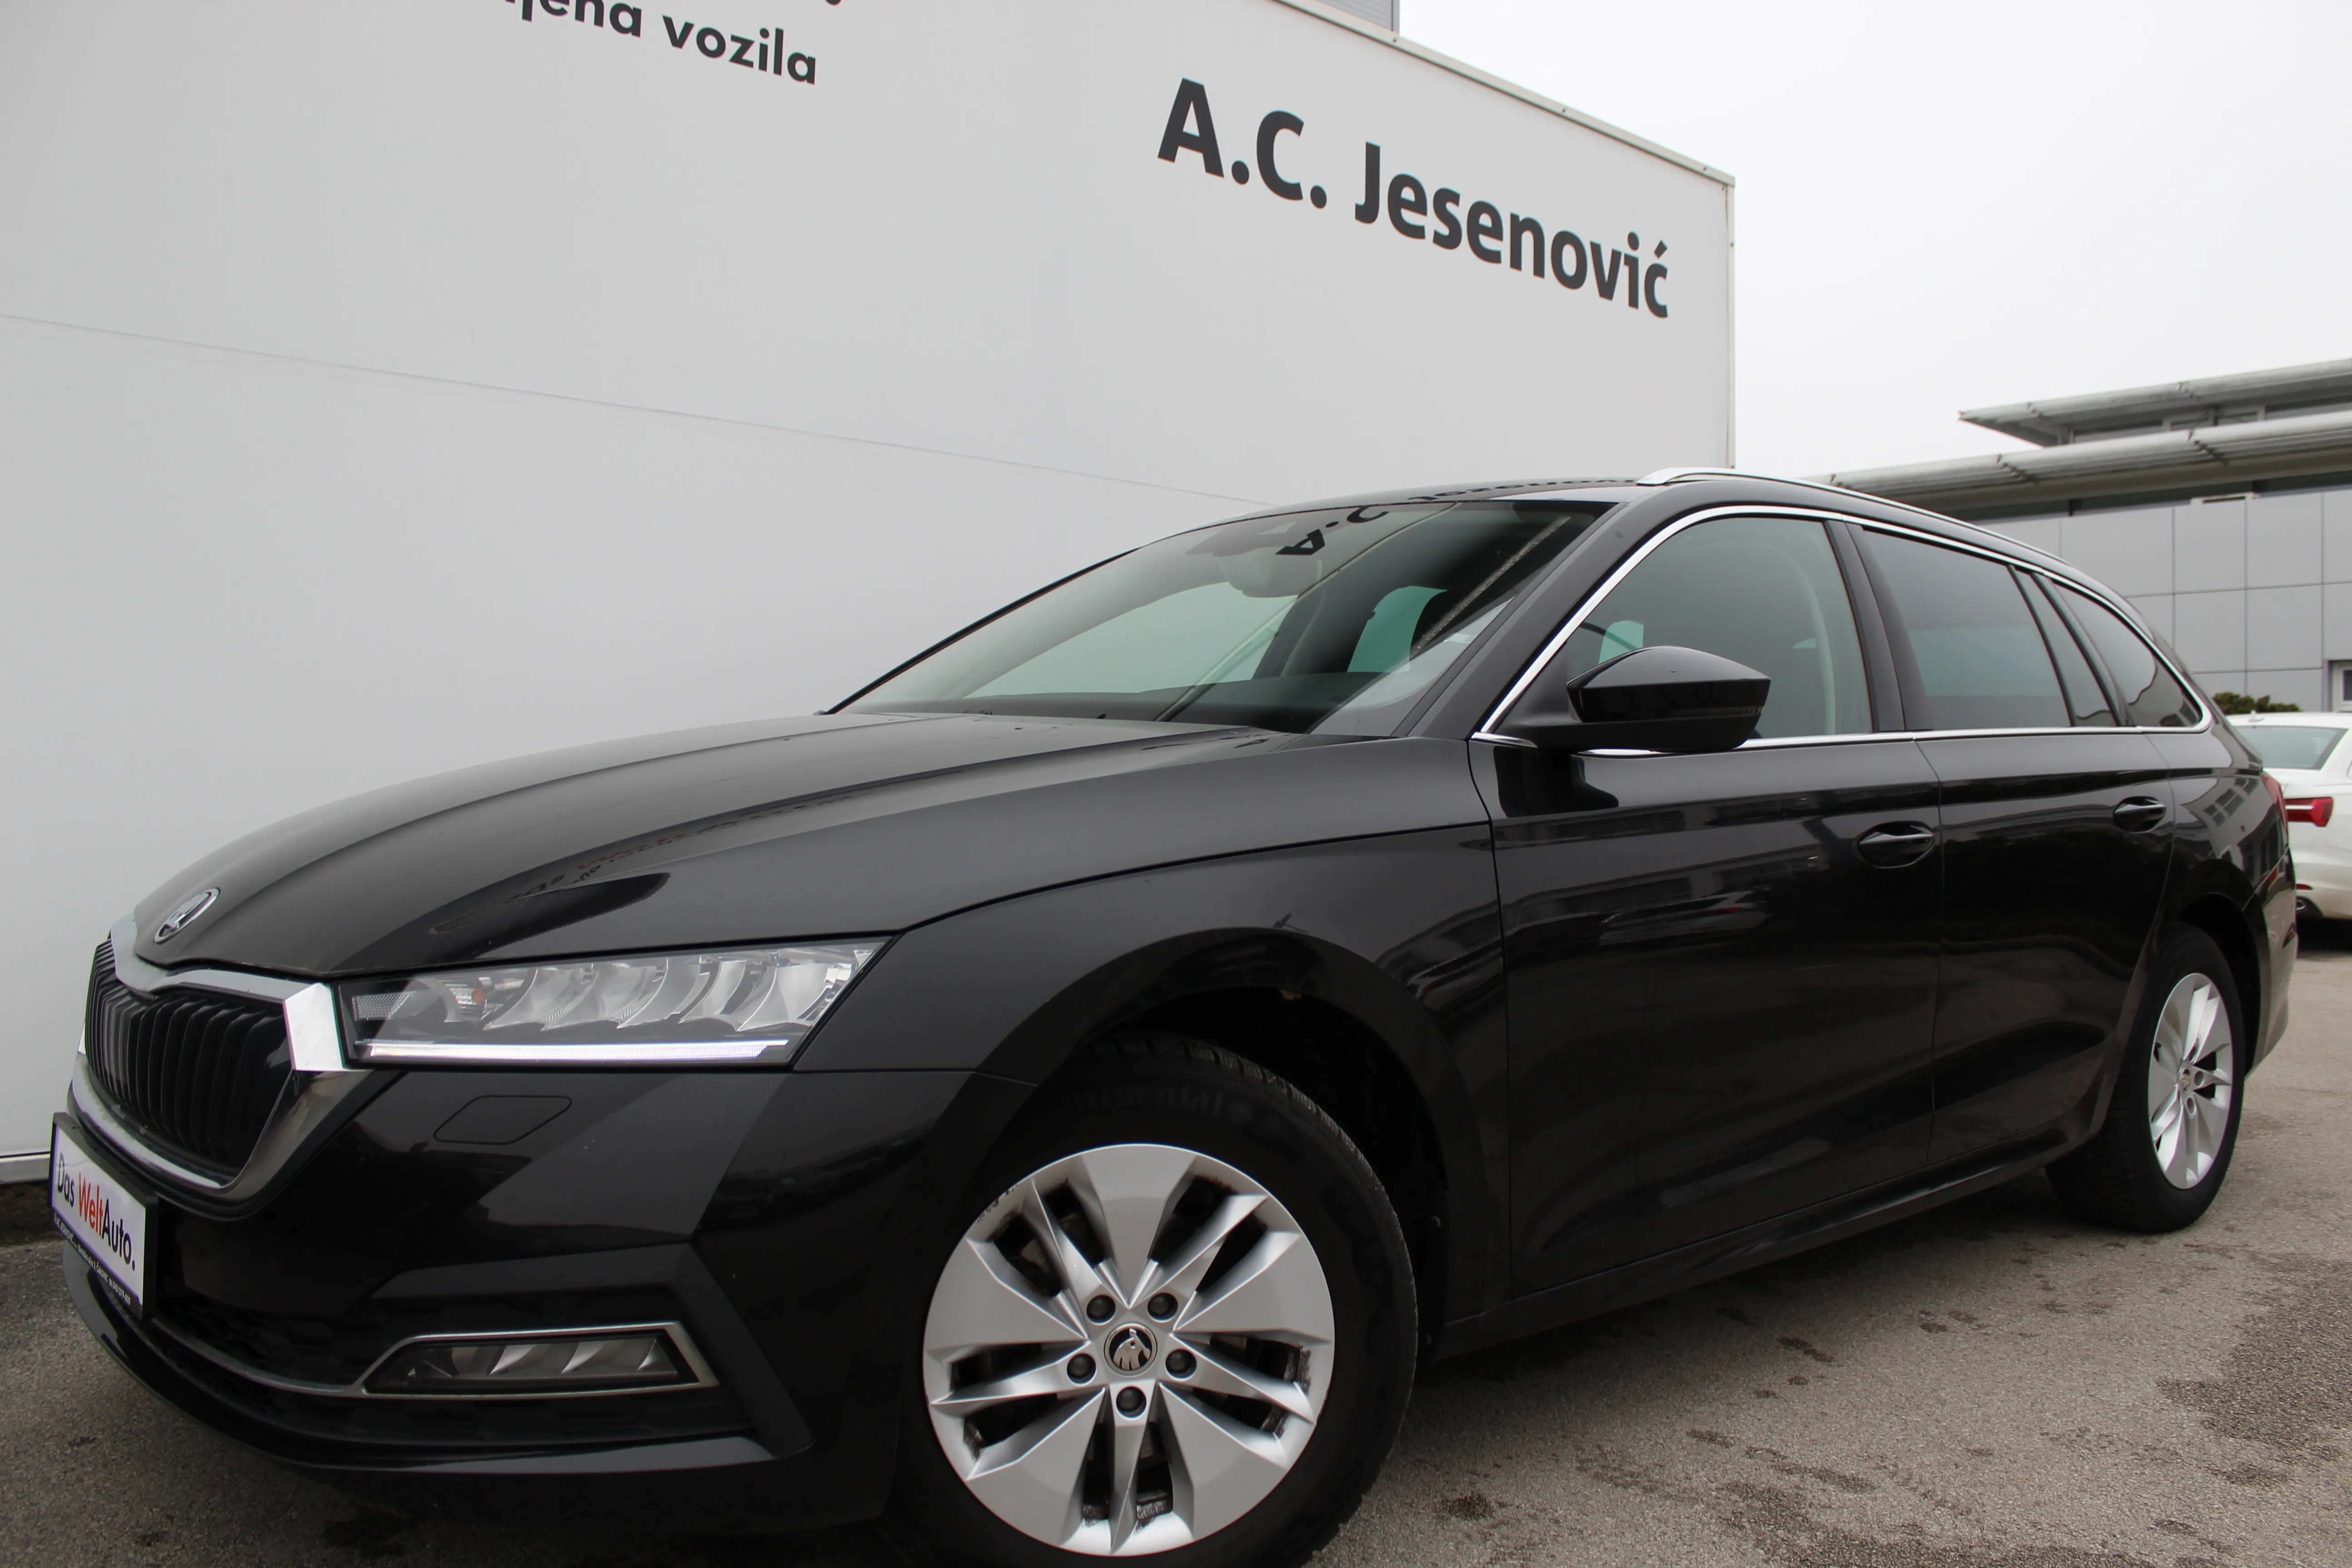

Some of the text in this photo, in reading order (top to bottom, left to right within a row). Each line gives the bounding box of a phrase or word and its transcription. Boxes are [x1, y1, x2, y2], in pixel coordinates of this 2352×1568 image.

[663, 16, 815, 84] vozila
[1158, 78, 1668, 318] A.C. Jesenović
[58, 1152, 136, 1271] Das WeltAuto.
